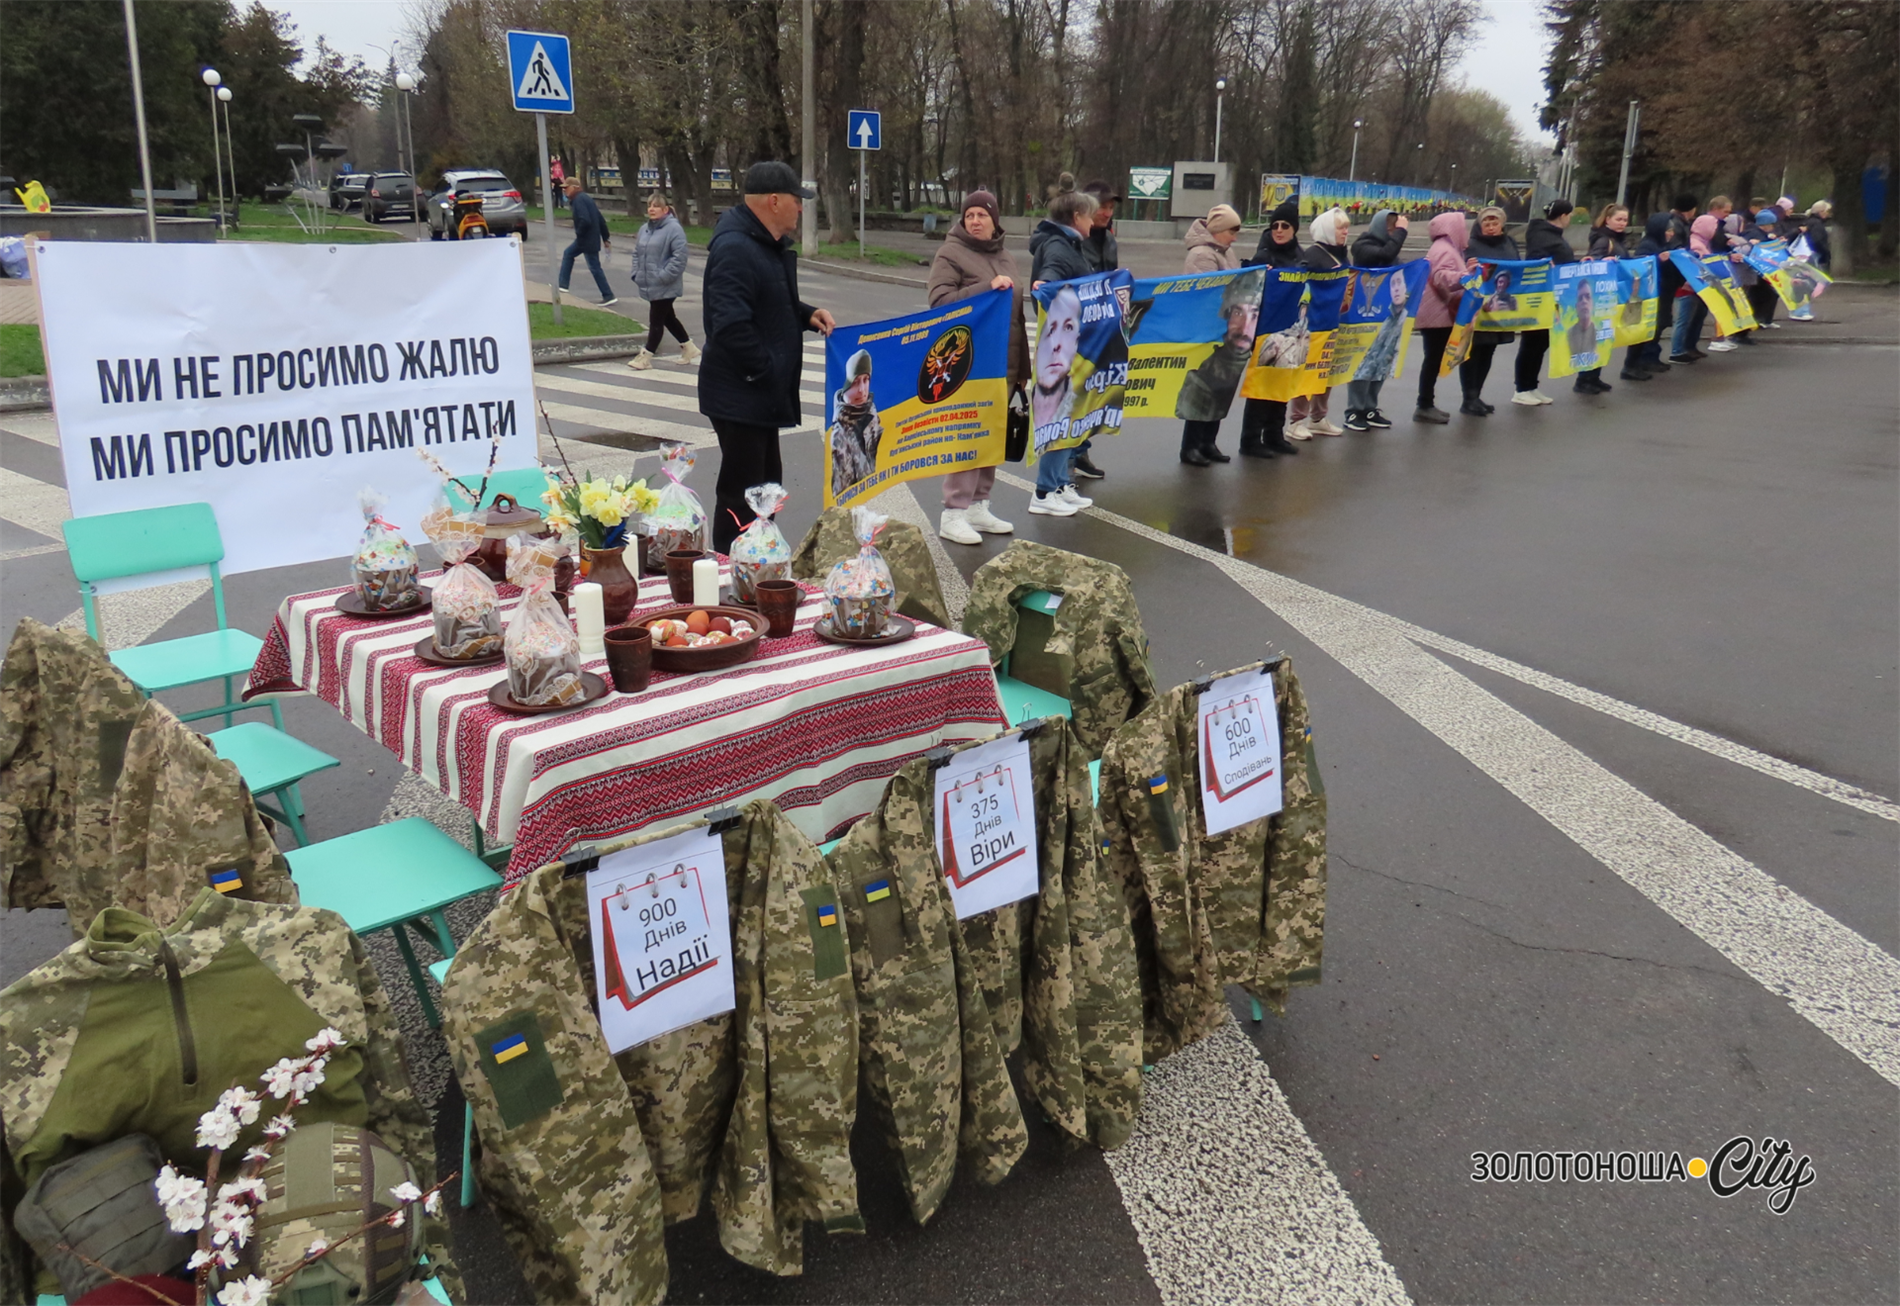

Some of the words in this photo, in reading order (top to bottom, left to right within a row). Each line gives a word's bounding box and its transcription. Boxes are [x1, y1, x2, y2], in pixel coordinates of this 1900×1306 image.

[96, 357, 163, 404] МИ
[173, 355, 222, 400] НЕ
[233, 342, 390, 396] ПРОСИМО
[395, 336, 501, 381] ЖАЛЮ
[1127, 356, 1188, 371] Валентин
[1125, 378, 1157, 391] ович
[1123, 395, 1141, 407] 997
[939, 410, 979, 423] 02.04.2025
[945, 421, 982, 432] напрямку
[90, 433, 155, 482] МИ
[163, 416, 334, 475] ПРОСИМО
[340, 400, 518, 454] ПАМ'ЯТАТИ
[923, 436, 943, 447] район
[891, 465, 899, 477] ТИ
[900, 454, 939, 473] БОРОВСЯ
[940, 453, 953, 464] ЗА
[955, 450, 978, 461] НАС!
[1225, 717, 1252, 741] 600
[1228, 736, 1257, 761] Днів
[1224, 754, 1273, 785] Сподівань
[970, 793, 999, 819] 375
[974, 814, 1002, 839] Днів
[970, 830, 1015, 866] Віри
[638, 897, 678, 928] 900
[644, 920, 687, 953] Днів
[635, 934, 710, 990] Надії
